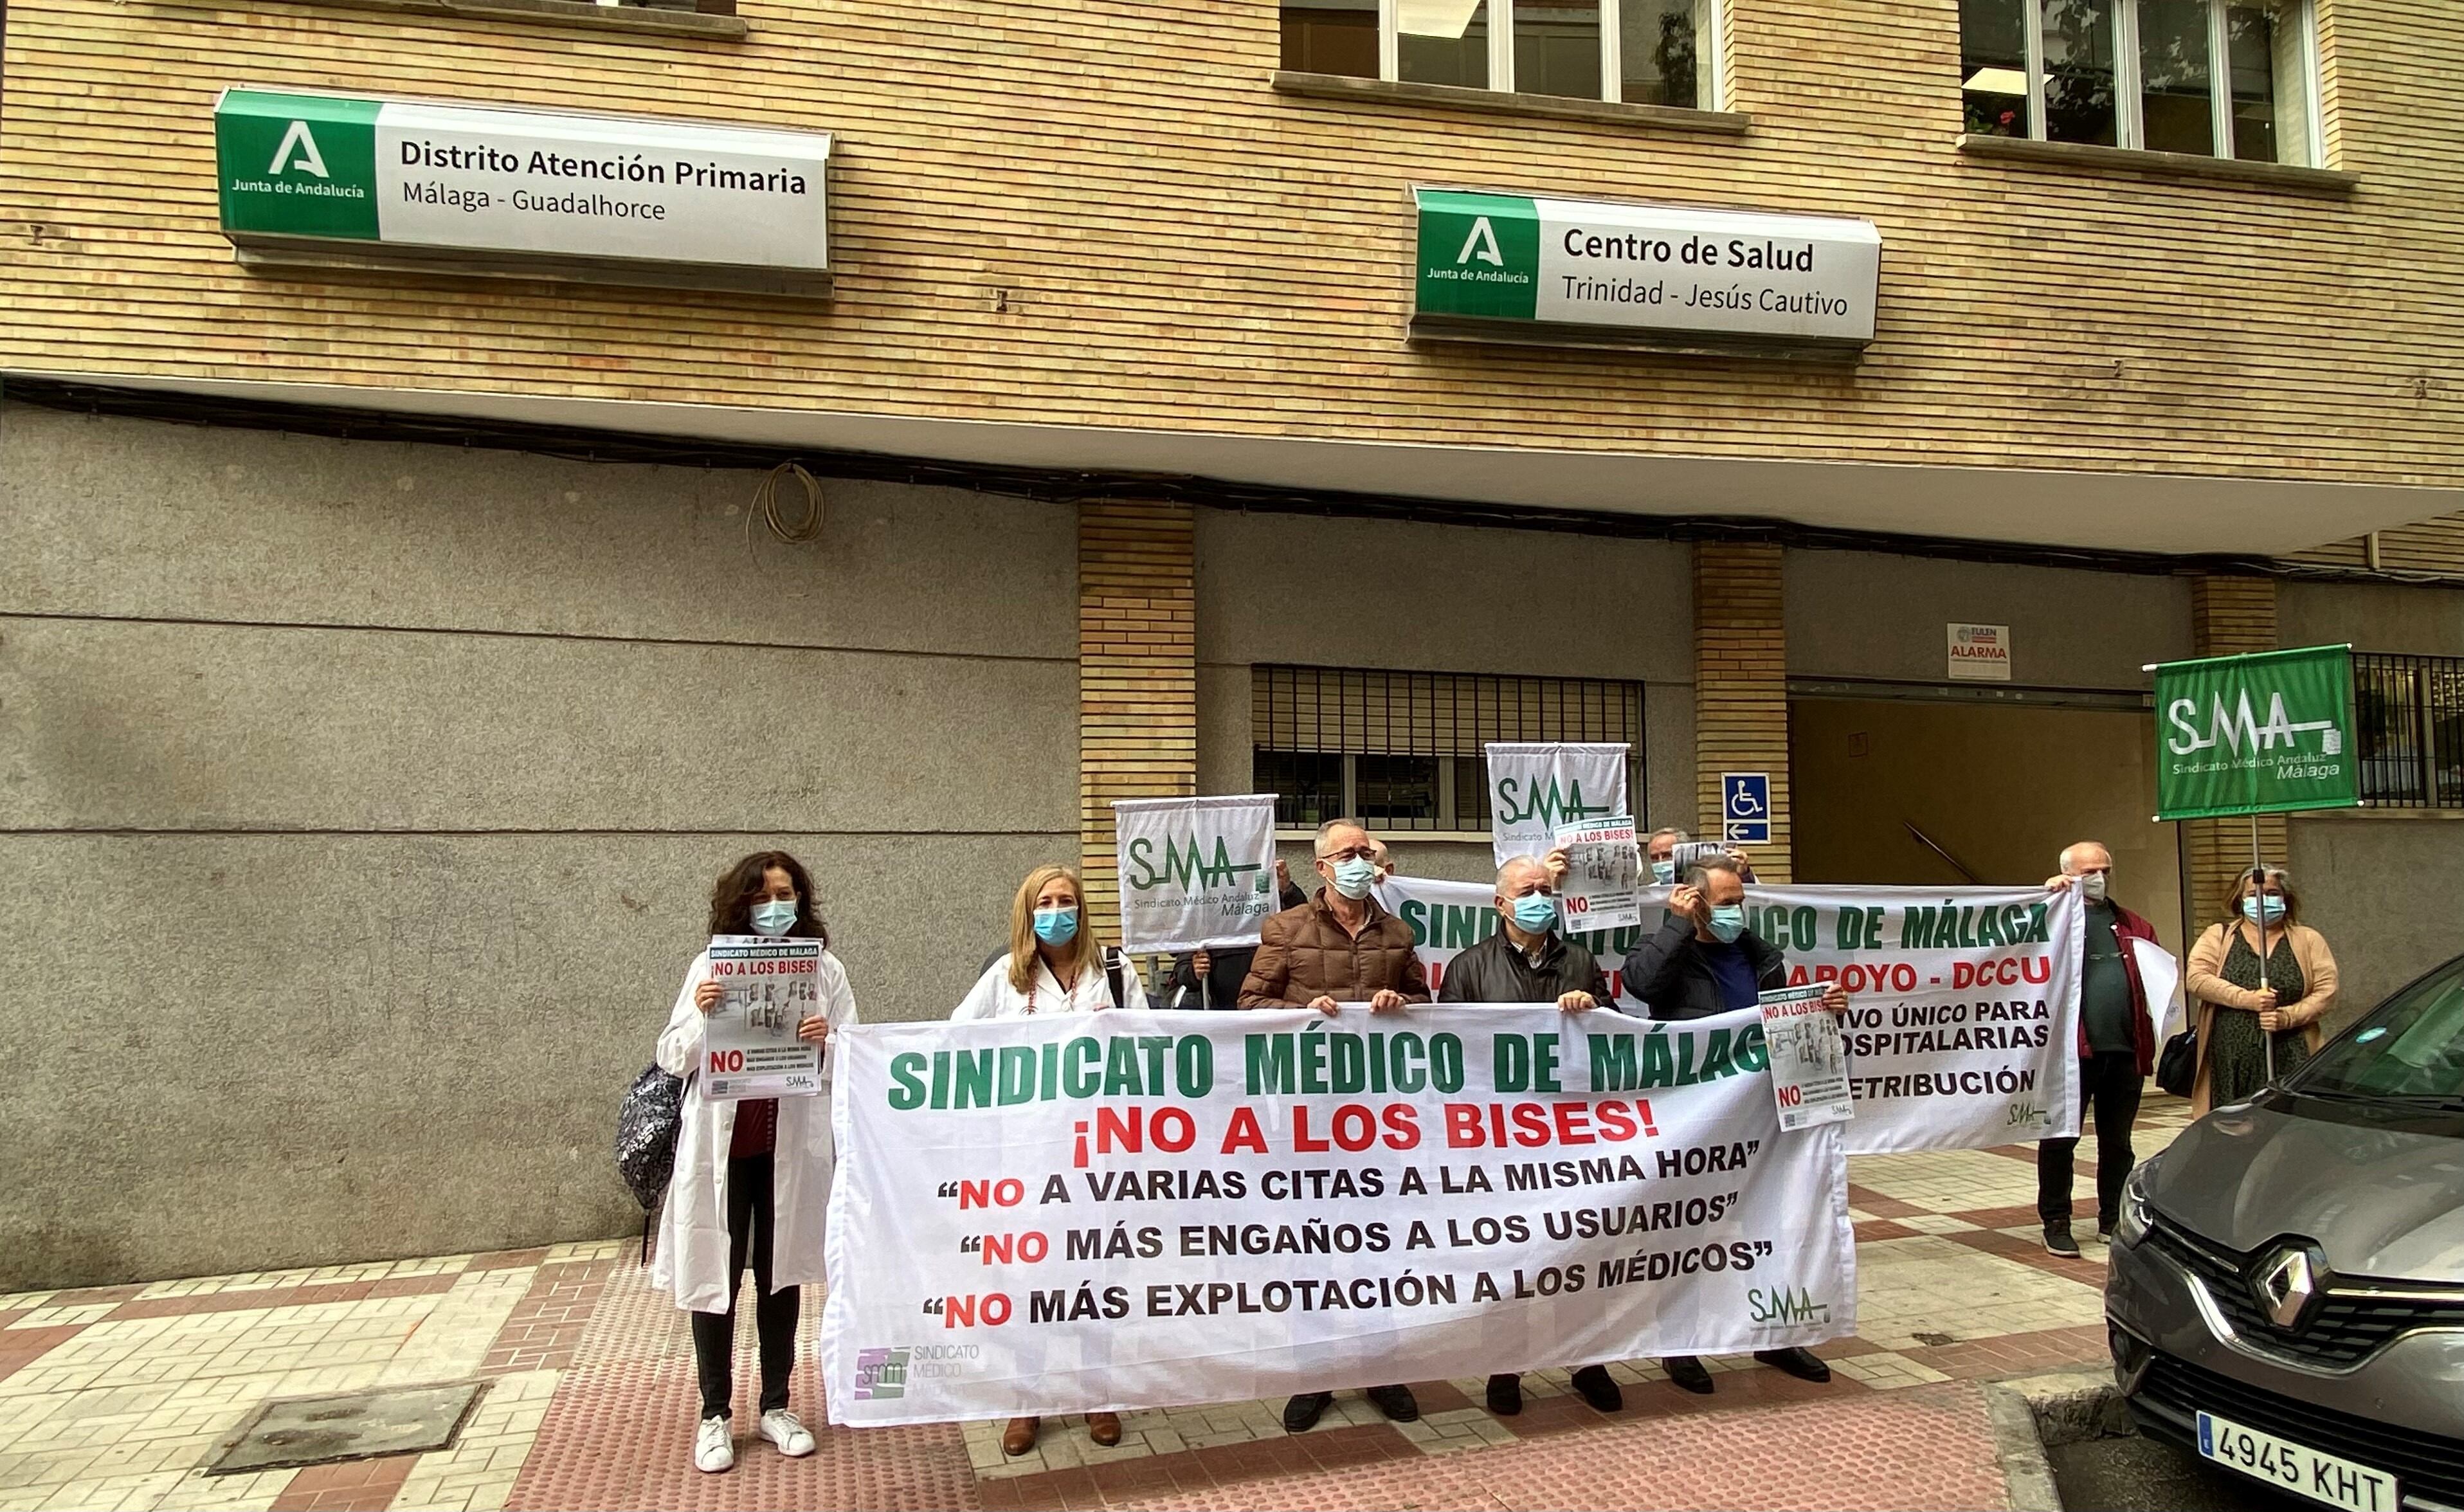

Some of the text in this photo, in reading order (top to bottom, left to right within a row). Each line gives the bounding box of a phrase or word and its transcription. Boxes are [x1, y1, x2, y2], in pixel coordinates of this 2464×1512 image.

[401, 140, 806, 196] Distrito Atención Primaria
[232, 179, 365, 198] Junta de Andalucía
[403, 181, 490, 212] Málaga
[512, 188, 666, 221] Guadalhorce
[1564, 228, 1813, 273] Centro de Salud
[1427, 268, 1529, 284] Junta de Andalucía
[1563, 275, 1663, 305] Trinidad
[1685, 283, 1753, 311] Jesús
[1759, 288, 1849, 316] Cautivo
[1950, 645, 2007, 659] ALARMA
[2168, 687, 2332, 757] SMA
[2173, 752, 2327, 775] Sindicato Médico Andaluz
[2276, 763, 2341, 781] Málaga
[1499, 773, 1610, 831] SMA
[1502, 832, 1543, 842] Sindicato
[1576, 833, 1582, 843] A
[1585, 831, 1602, 843] LOS
[1604, 828, 1634, 841] BISES!
[1129, 828, 1262, 895] SMA
[1134, 891, 1260, 909] Sindicato Médico Andaluz
[1221, 900, 1270, 918] Málaga
[1566, 896, 1588, 915] NO
[1836, 906, 1885, 951] DE
[1900, 898, 2051, 950] MÁLAGA
[711, 949, 748, 958] SINDICATO
[711, 959, 817, 978] ¡NO A LOS BISES!
[1953, 956, 2051, 990] DCCU
[1781, 1005, 1789, 1017] A
[1789, 1001, 1808, 1016] LOS
[1891, 1002, 1967, 1030] ÚNICO
[1975, 999, 2050, 1023] PARA
[1841, 1024, 2049, 1057] OSPITALARIAS
[711, 1050, 744, 1073] NO
[887, 1019, 1771, 1111] SINDICATO MÉDICO DE MÁLAG
[1778, 1084, 1800, 1108] NO
[1849, 1064, 2036, 1100] ETRIBUCIÓN
[1073, 1098, 1659, 1169] ¡NO A LOS BISES!
[1039, 1174, 1071, 1205] A
[1085, 1169, 1247, 1202] VARIAS
[1260, 1167, 1385, 1201] CITAS
[1398, 1166, 1428, 1197] A
[1440, 1160, 1494, 1195] LA
[1505, 1156, 1647, 1192] MISMA
[1065, 1219, 1164, 1262] MÁS
[1179, 1217, 1391, 1257] ENGAÑOS
[1405, 1219, 1436, 1251] A
[1447, 1213, 1531, 1248] LOS
[1029, 1279, 1130, 1324] MÁS
[1146, 1268, 1457, 1318] EXPLOTACIÓN
[1471, 1271, 1502, 1303] A
[1512, 1262, 1586, 1299] LOS
[1747, 1284, 1828, 1328] SMA
[914, 1344, 980, 1361] SINDICATO
[913, 1362, 962, 1379] MÉDICO
[2219, 1426, 2384, 1512] 4945 KHT
